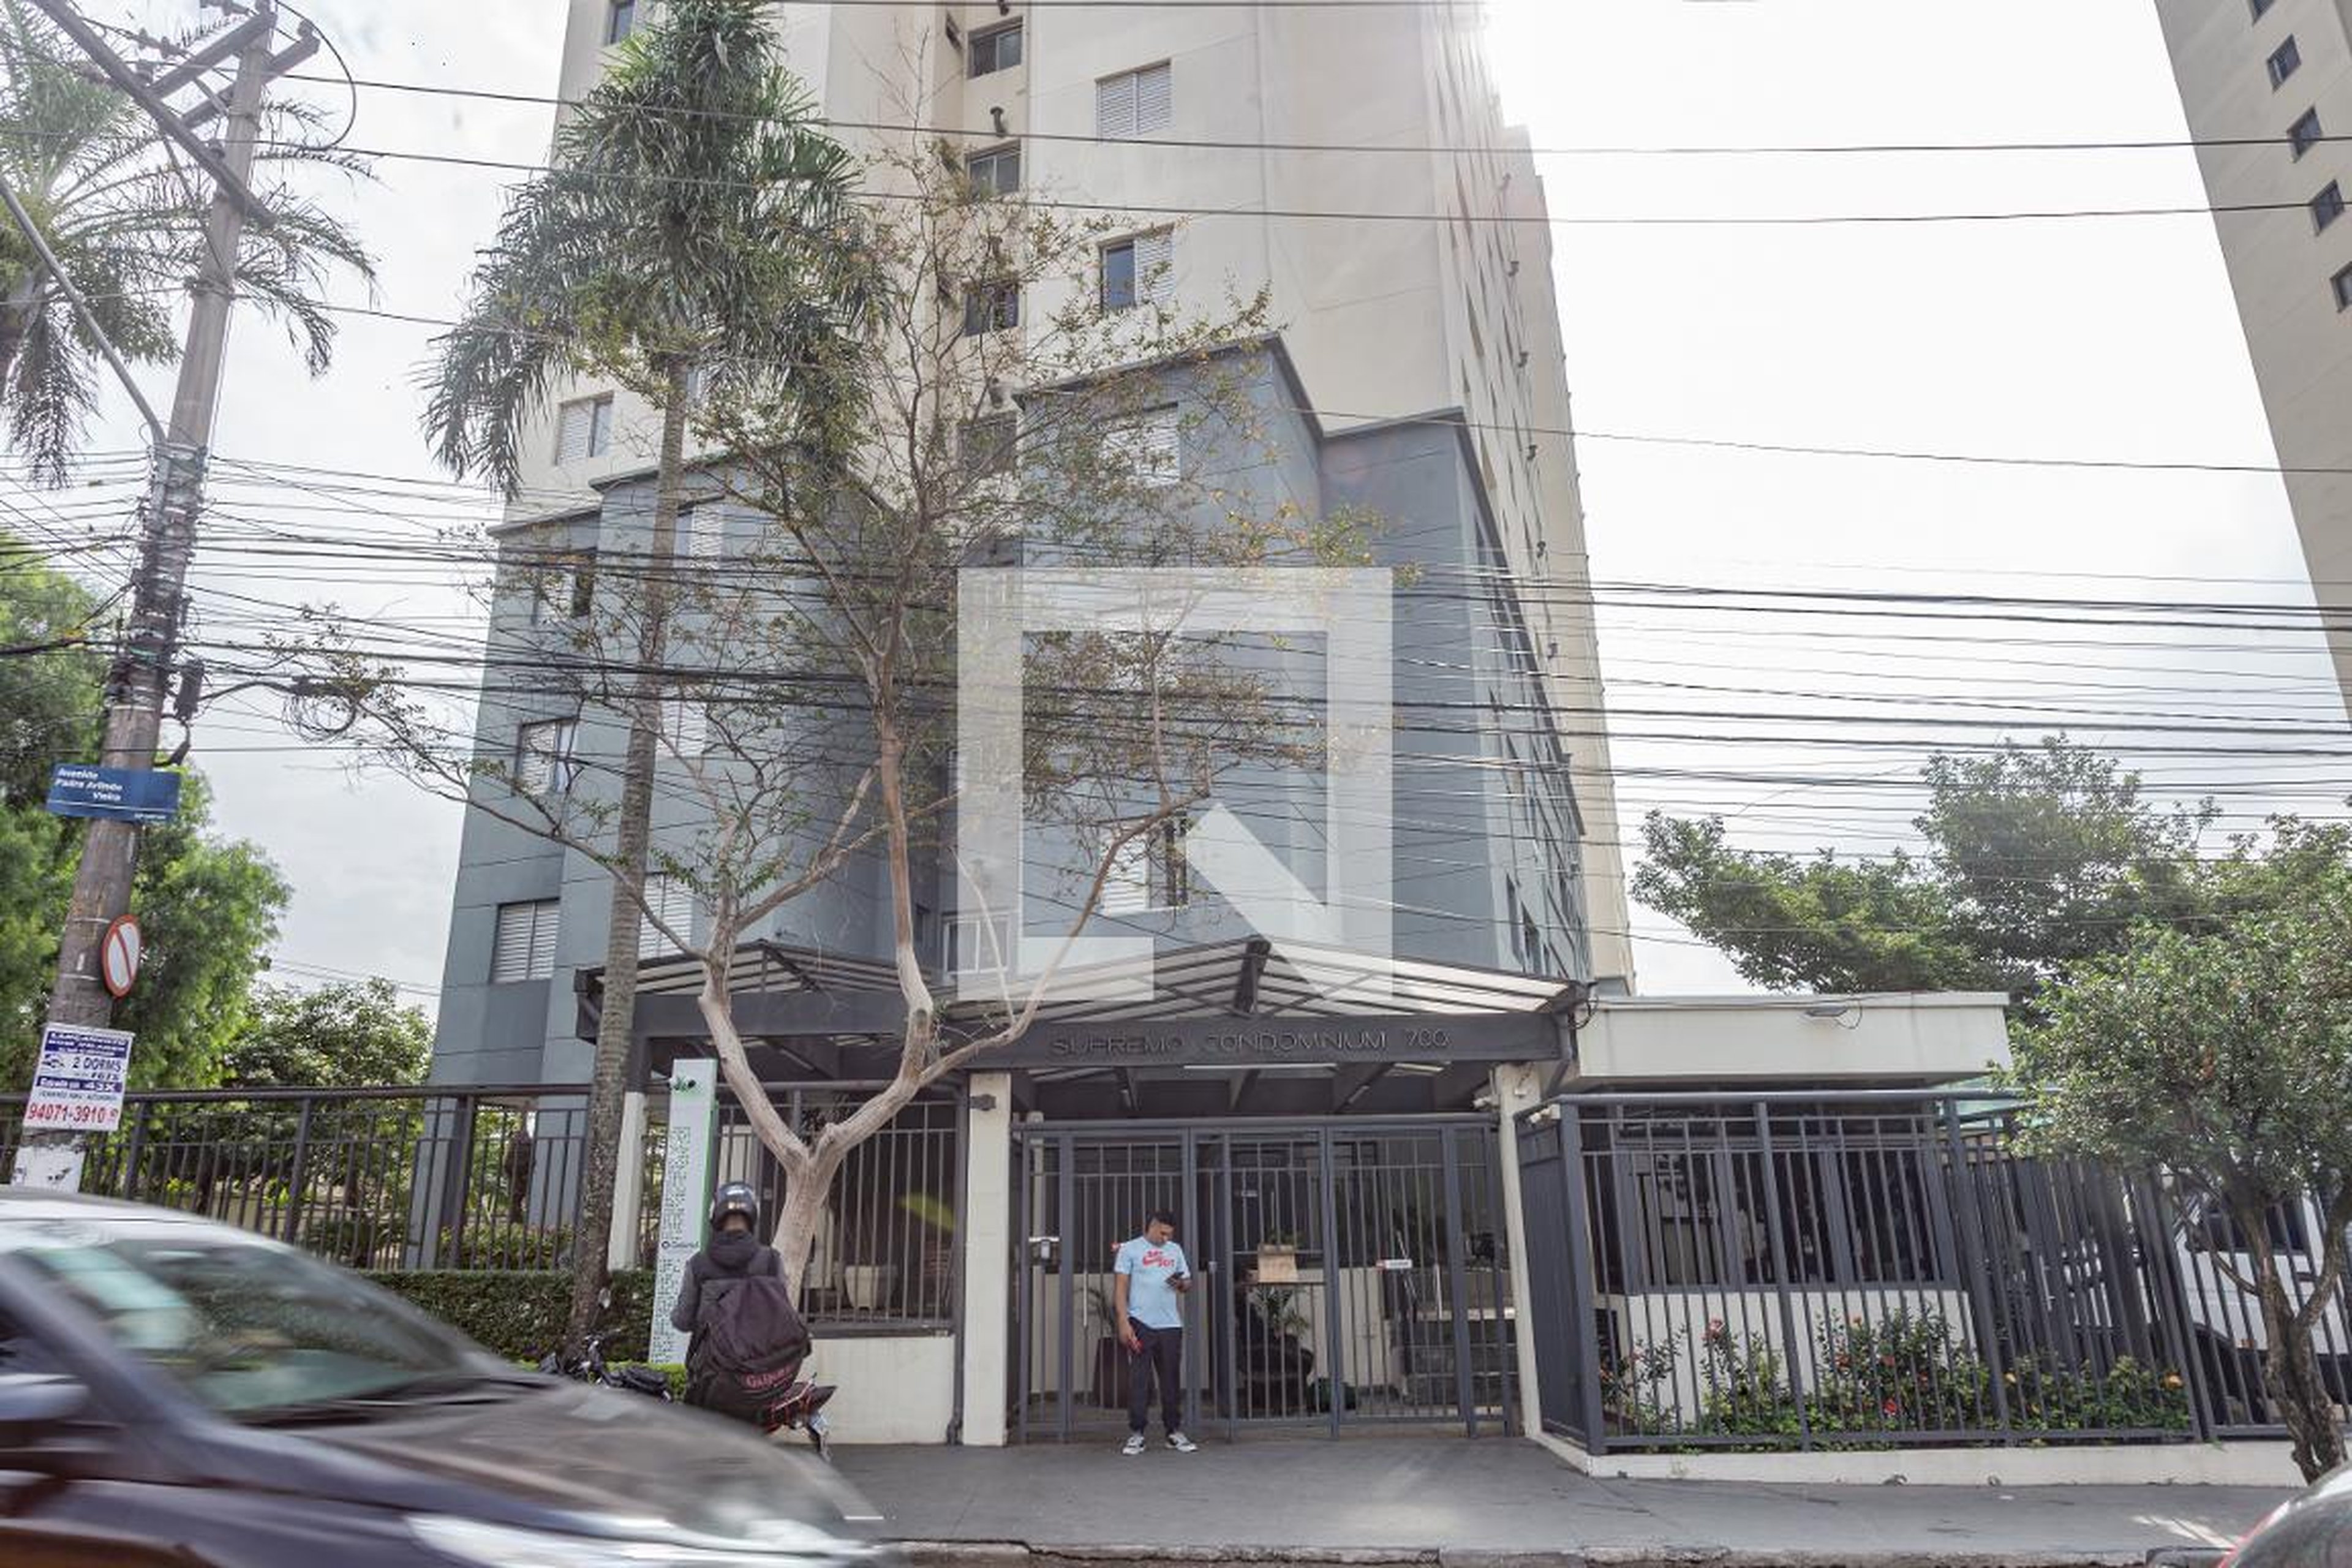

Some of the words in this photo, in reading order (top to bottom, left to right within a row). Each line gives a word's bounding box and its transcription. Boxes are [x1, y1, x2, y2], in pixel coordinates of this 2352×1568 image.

[58, 767, 99, 780] Avenida
[1052, 1037, 1183, 1054] SUPREMO
[72, 1057, 80, 1069] 2
[28, 1102, 105, 1124] 94071-3910
